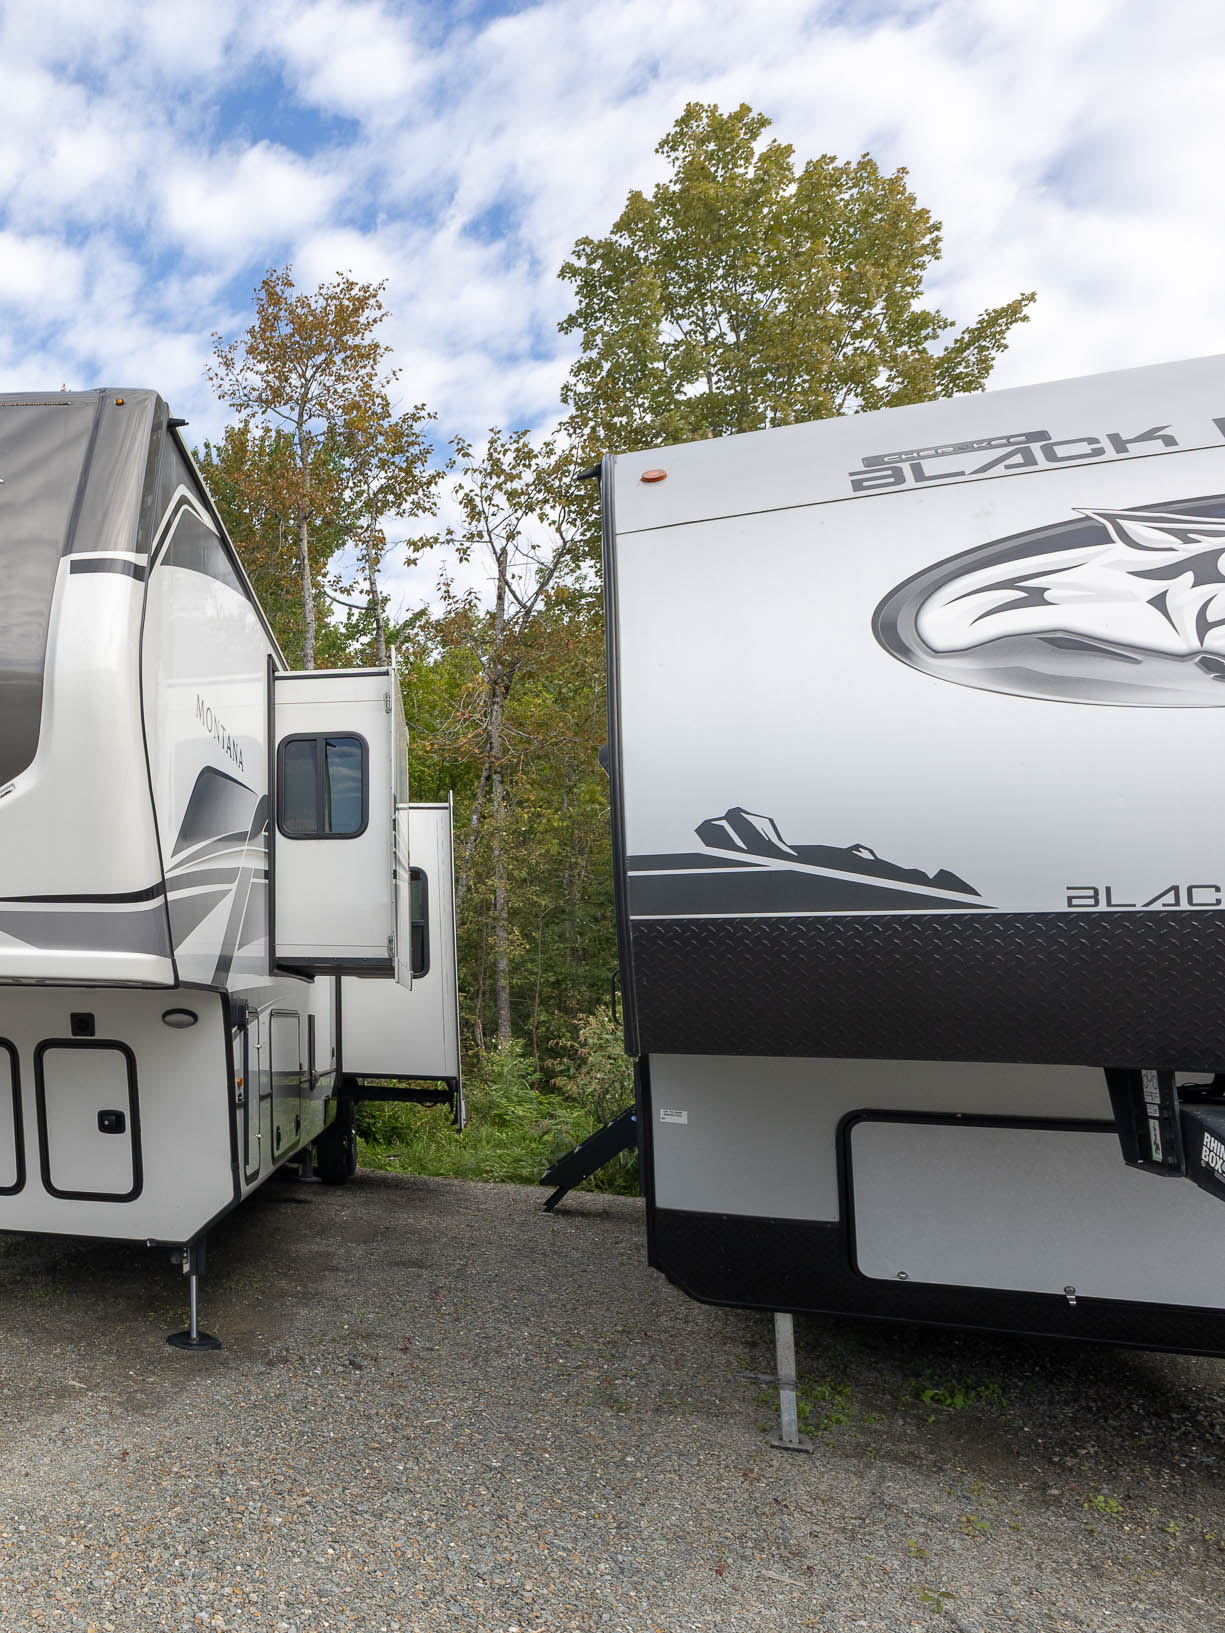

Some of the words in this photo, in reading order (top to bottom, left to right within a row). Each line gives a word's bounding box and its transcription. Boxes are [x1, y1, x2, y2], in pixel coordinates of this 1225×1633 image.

[848, 425, 1179, 492] BLACK
[196, 693, 244, 773] MONTANA
[1066, 884, 1222, 908] BLAC
